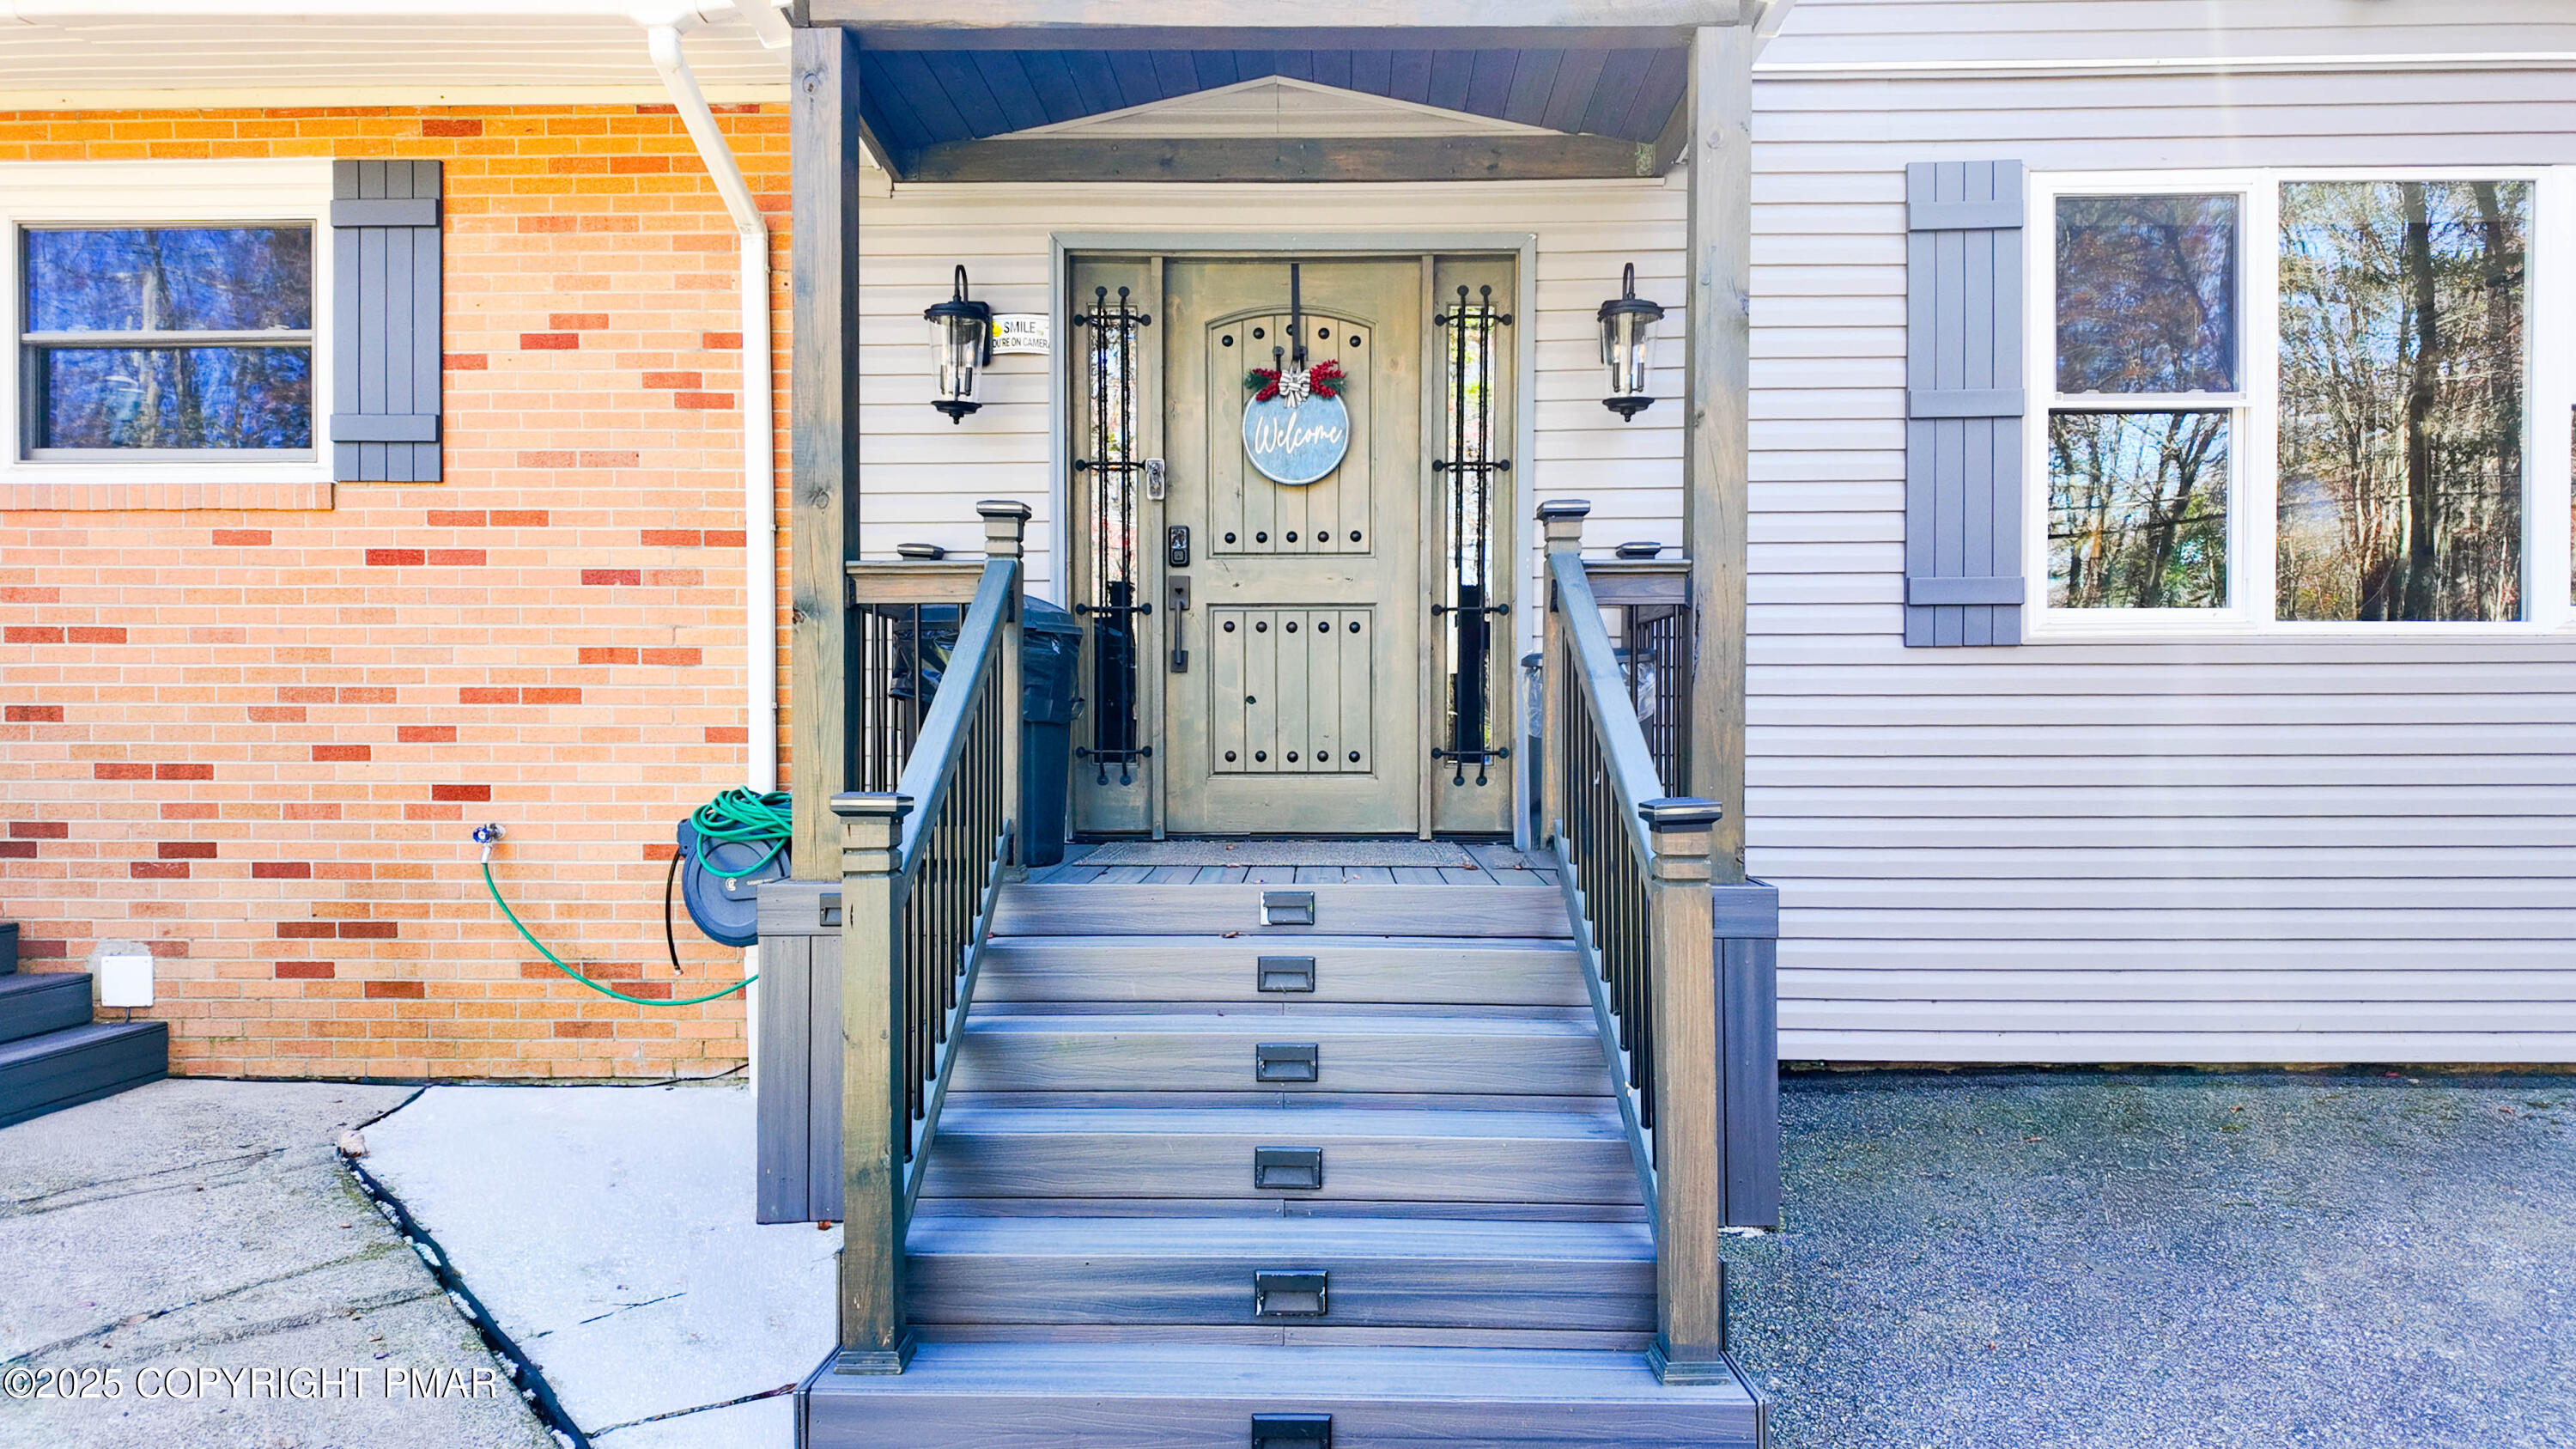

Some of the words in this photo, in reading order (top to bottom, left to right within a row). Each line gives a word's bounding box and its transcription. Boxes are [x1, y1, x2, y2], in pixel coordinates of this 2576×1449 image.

[1003, 321, 1036, 333] SMILE
[992, 338, 1010, 348] OU'RE
[1012, 337, 1021, 346] ON
[1255, 411, 1342, 454] Welcome
